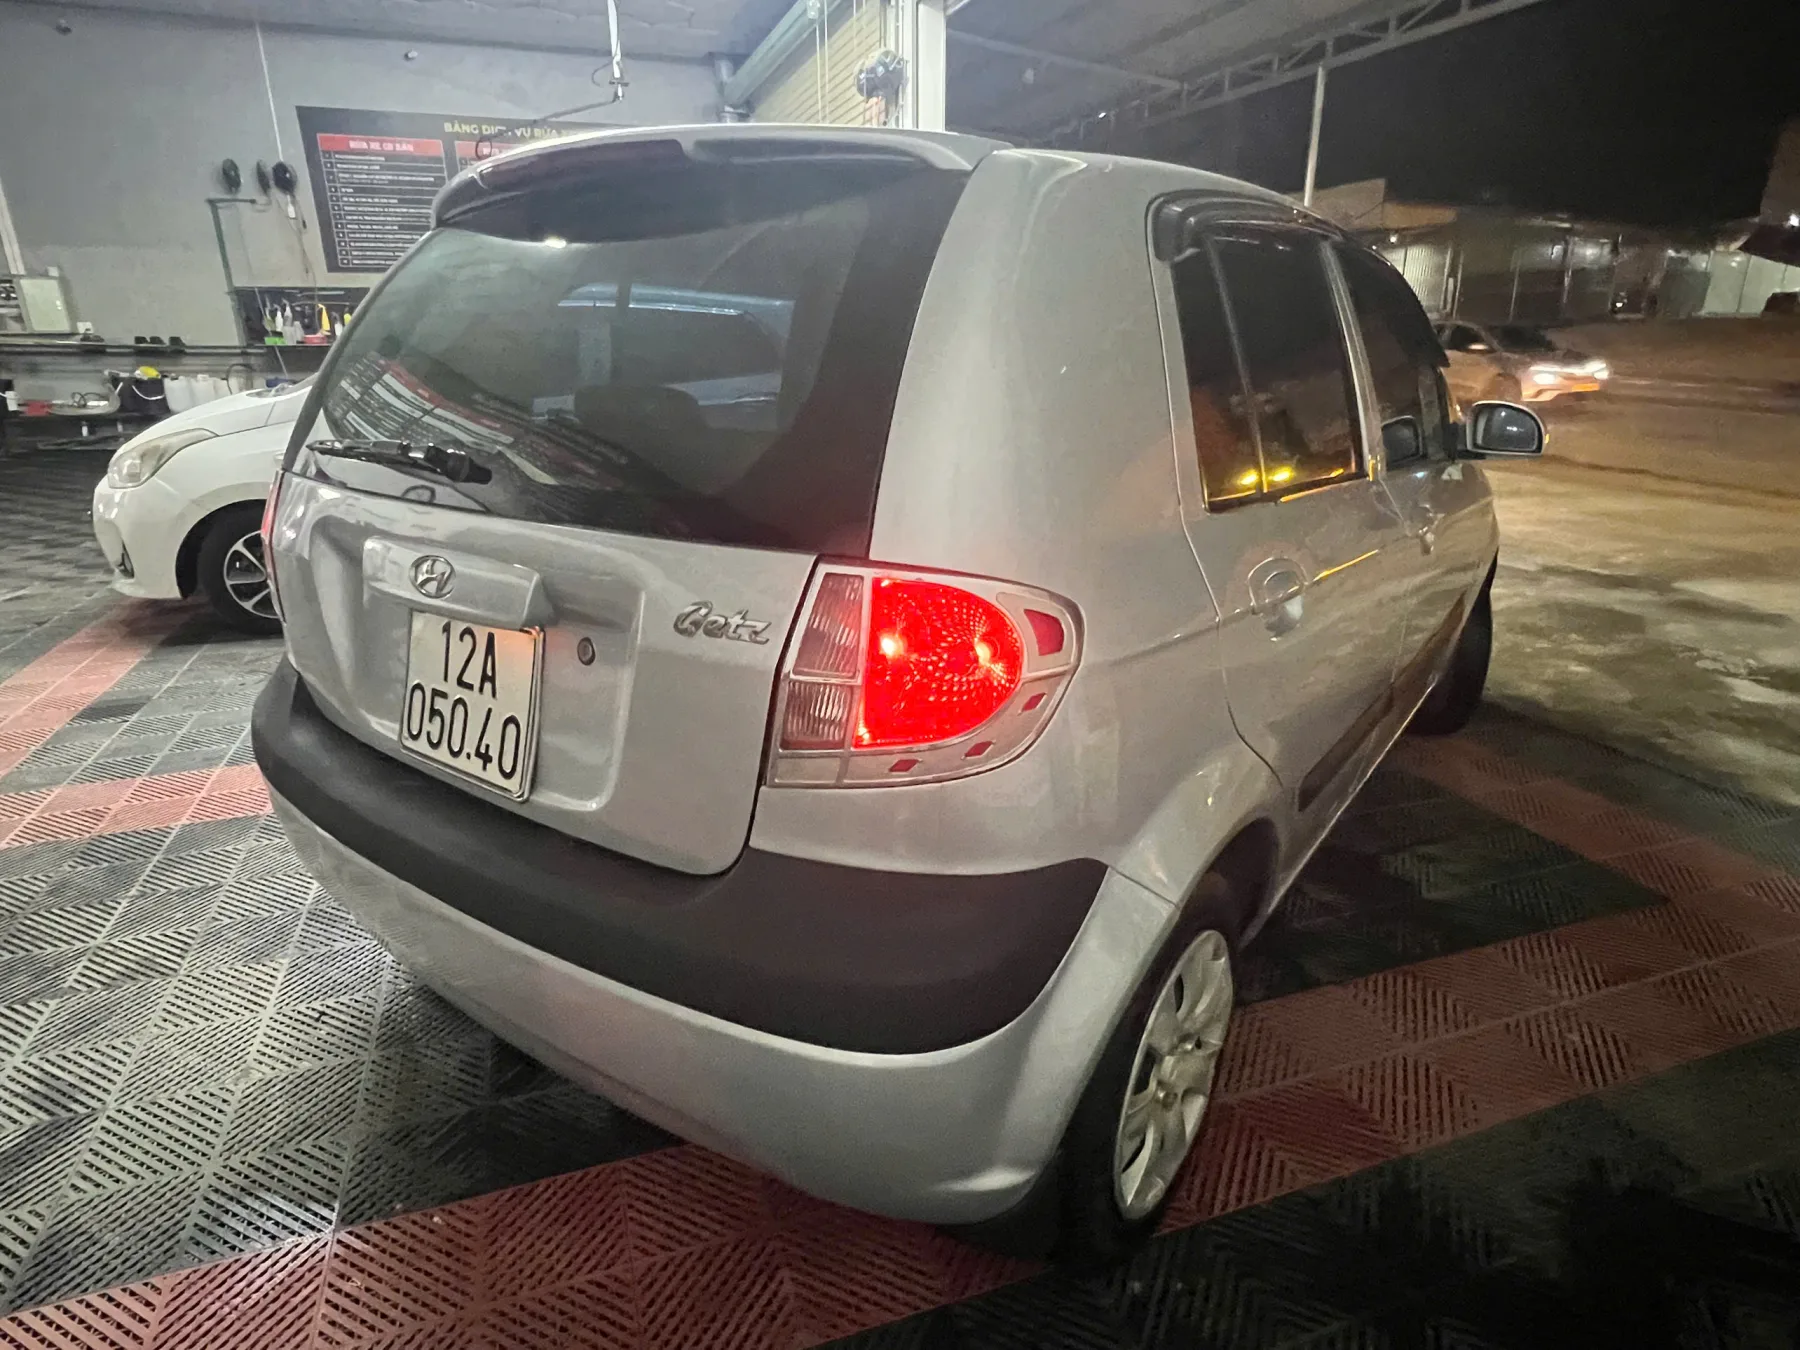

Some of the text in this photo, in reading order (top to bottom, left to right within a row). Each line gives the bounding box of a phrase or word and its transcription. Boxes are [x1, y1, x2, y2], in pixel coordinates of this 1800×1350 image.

[442, 620, 497, 698] 12A
[673, 600, 772, 645] Getz
[407, 682, 521, 780] 050.40
